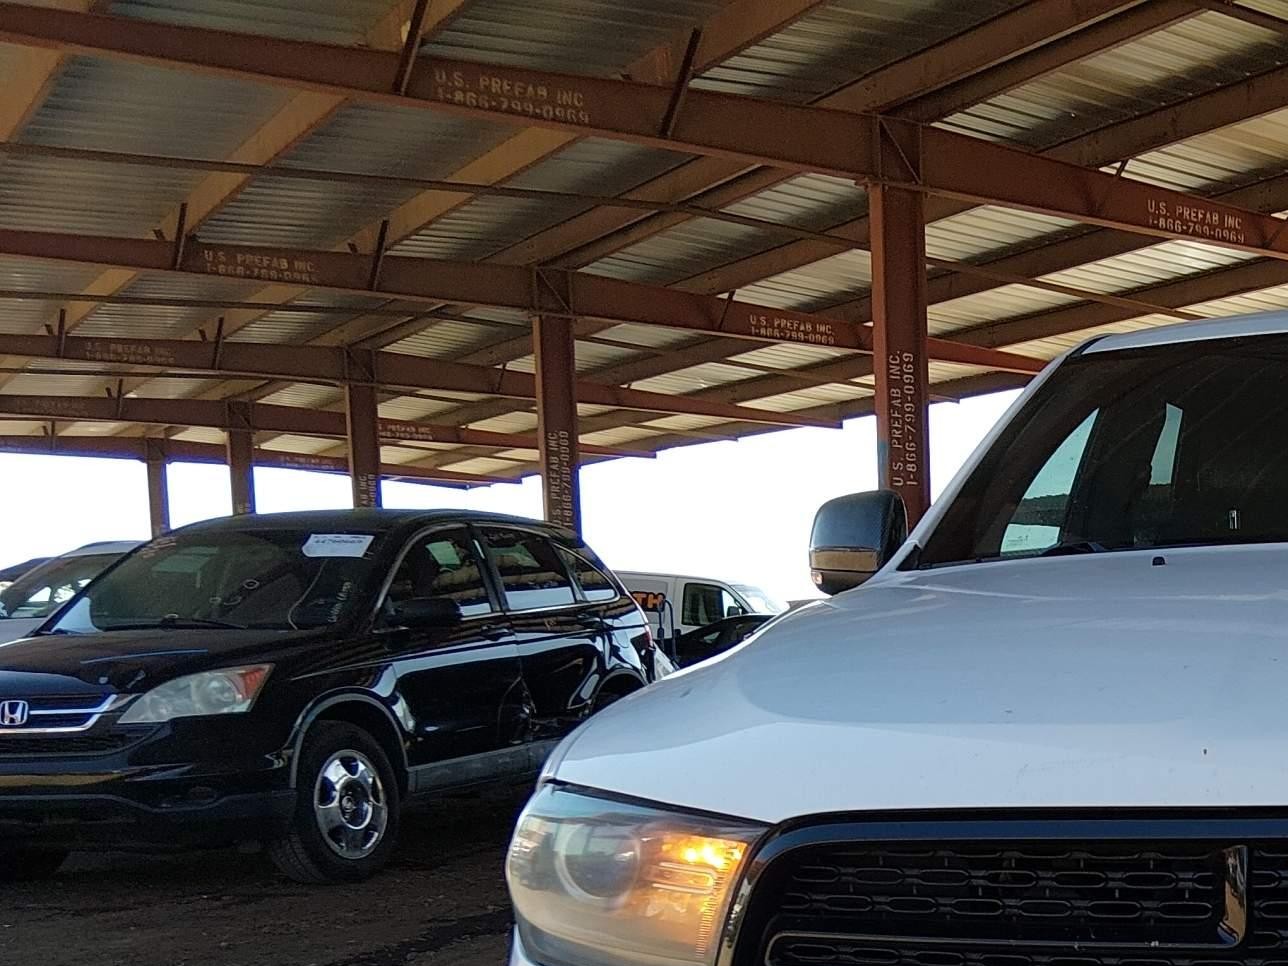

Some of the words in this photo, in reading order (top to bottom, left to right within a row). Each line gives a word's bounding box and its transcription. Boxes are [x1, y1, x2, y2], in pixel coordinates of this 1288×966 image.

[435, 71, 470, 88] U.S.
[479, 76, 548, 99] PREFAB
[1147, 199, 1170, 216] U.S.
[1176, 206, 1220, 225] PREFAB
[774, 318, 812, 332] PREFAB
[888, 350, 901, 380] INC.
[890, 388, 903, 449] PREFAB
[902, 352, 918, 486] 1-866-799-0969
[892, 458, 905, 486] U.S.
